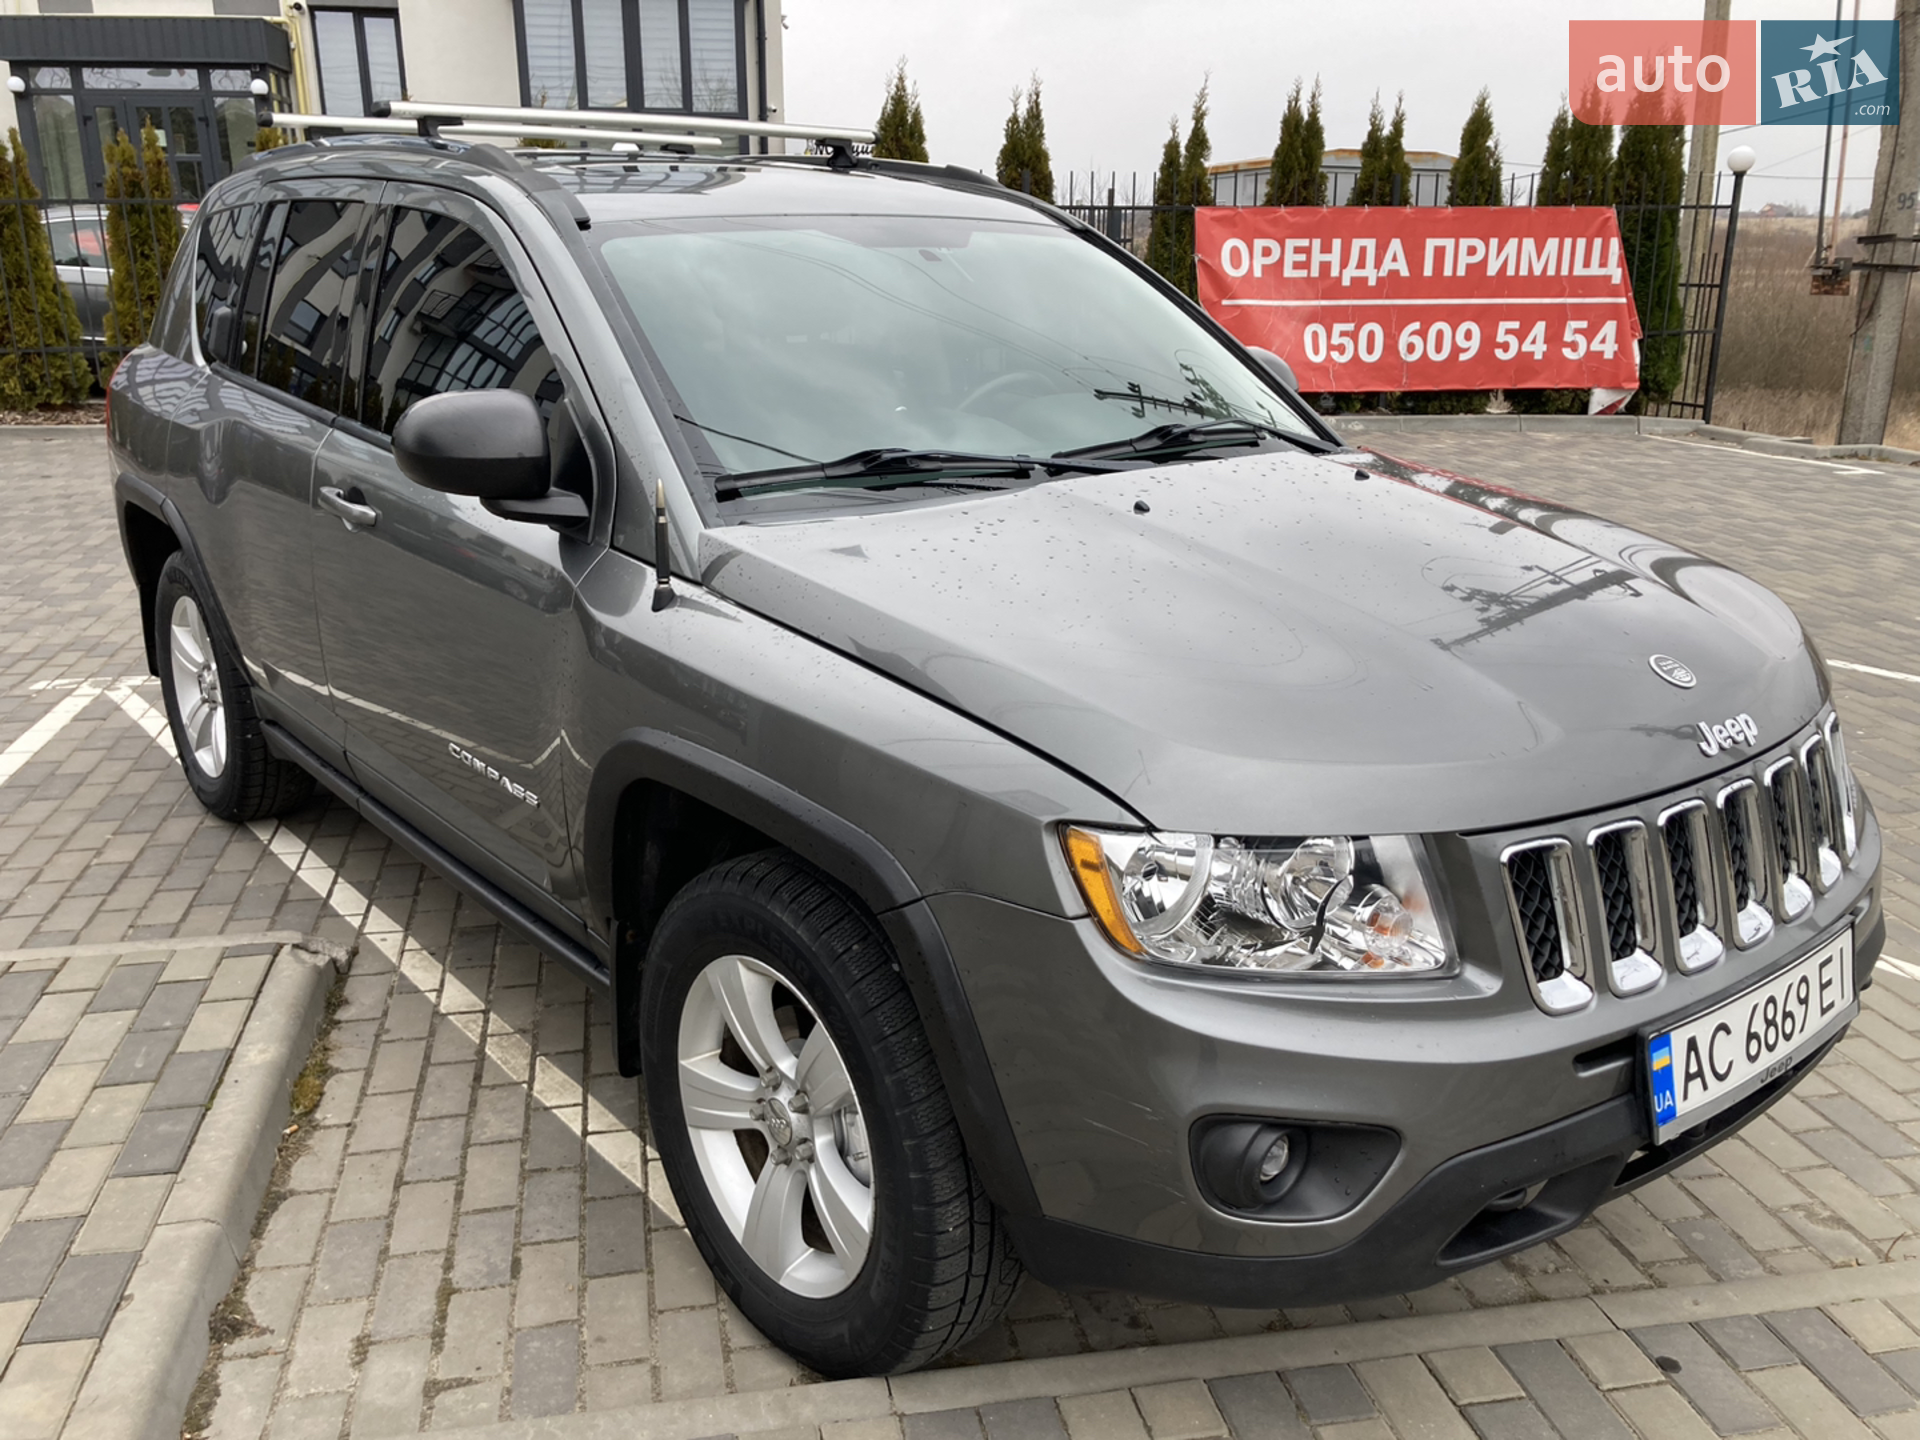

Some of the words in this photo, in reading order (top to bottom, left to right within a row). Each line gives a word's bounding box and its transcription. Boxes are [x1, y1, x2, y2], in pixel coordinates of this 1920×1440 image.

[1897, 192, 1918, 210] 95
[1220, 237, 1410, 286] ОРЕНДА
[1422, 236, 1623, 285] ПРИМІЩ
[1303, 322, 1385, 363] 050
[1398, 320, 1481, 362] 609
[1494, 320, 1547, 361] 54
[1561, 320, 1618, 360] 54
[1698, 713, 1758, 755] Jeep
[448, 742, 539, 807] COMPASS
[1682, 1022, 1734, 1102] AC
[1745, 974, 1810, 1064] 6869
[1818, 946, 1845, 1017] EI
[1760, 1056, 1793, 1084] Jeep
[1654, 1090, 1674, 1112] UA
